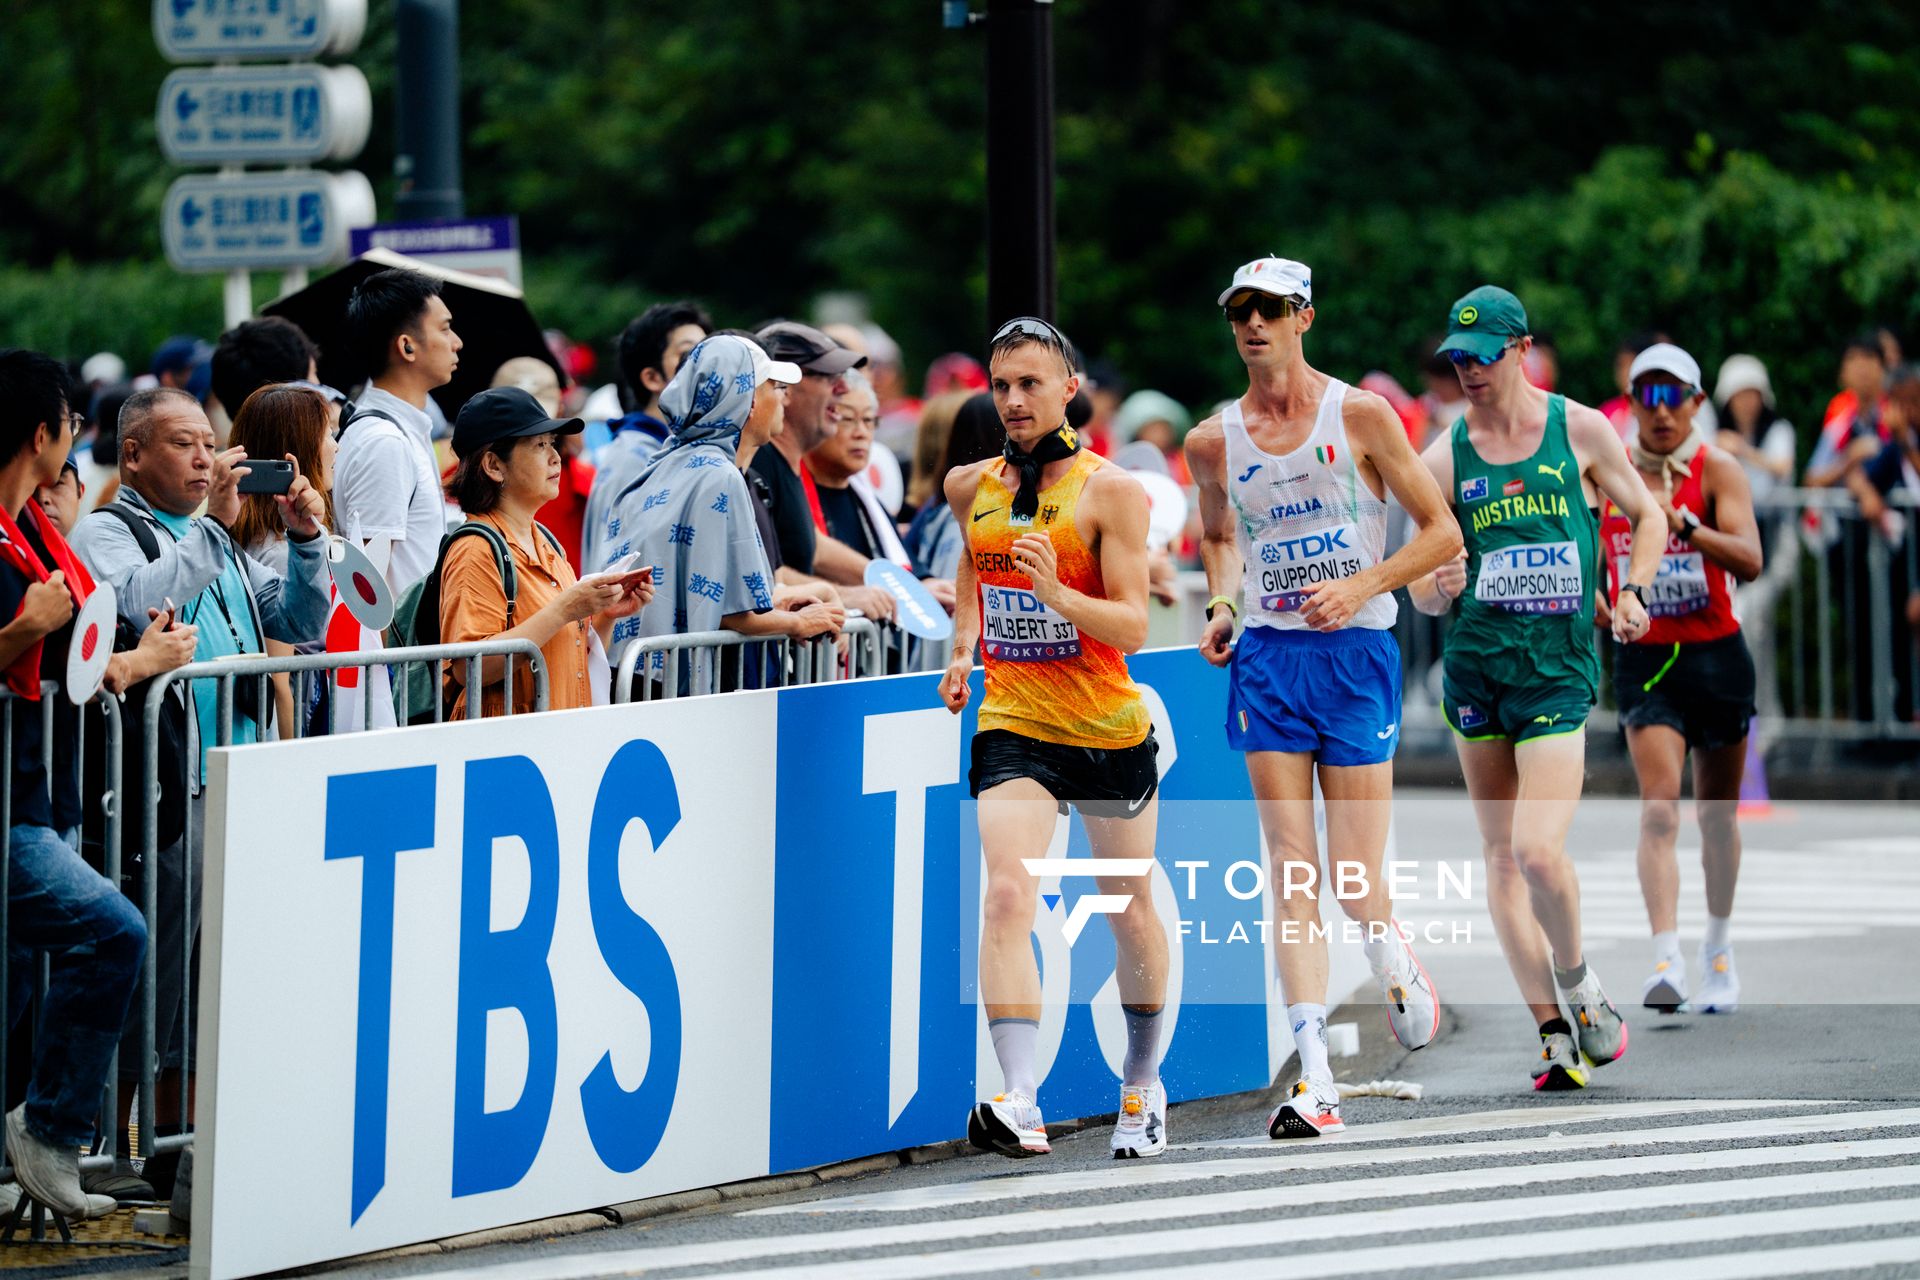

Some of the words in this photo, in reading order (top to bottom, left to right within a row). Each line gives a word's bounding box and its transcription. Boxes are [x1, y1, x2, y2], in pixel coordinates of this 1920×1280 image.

[1271, 497, 1323, 519] ITALIA
[1472, 493, 1570, 534] AUSTRALIA
[1277, 528, 1351, 561] TDK
[1504, 546, 1571, 569] TDK
[976, 552, 1037, 574] GERM
[1262, 558, 1339, 592] GIUPPONI
[1341, 557, 1362, 577] 351
[687, 572, 725, 603] 激走
[1480, 572, 1557, 598] THOMPSON
[1560, 577, 1580, 594] 303
[986, 614, 1048, 641] HILBERT
[1053, 621, 1074, 640] 337
[324, 738, 682, 1228] TBS
